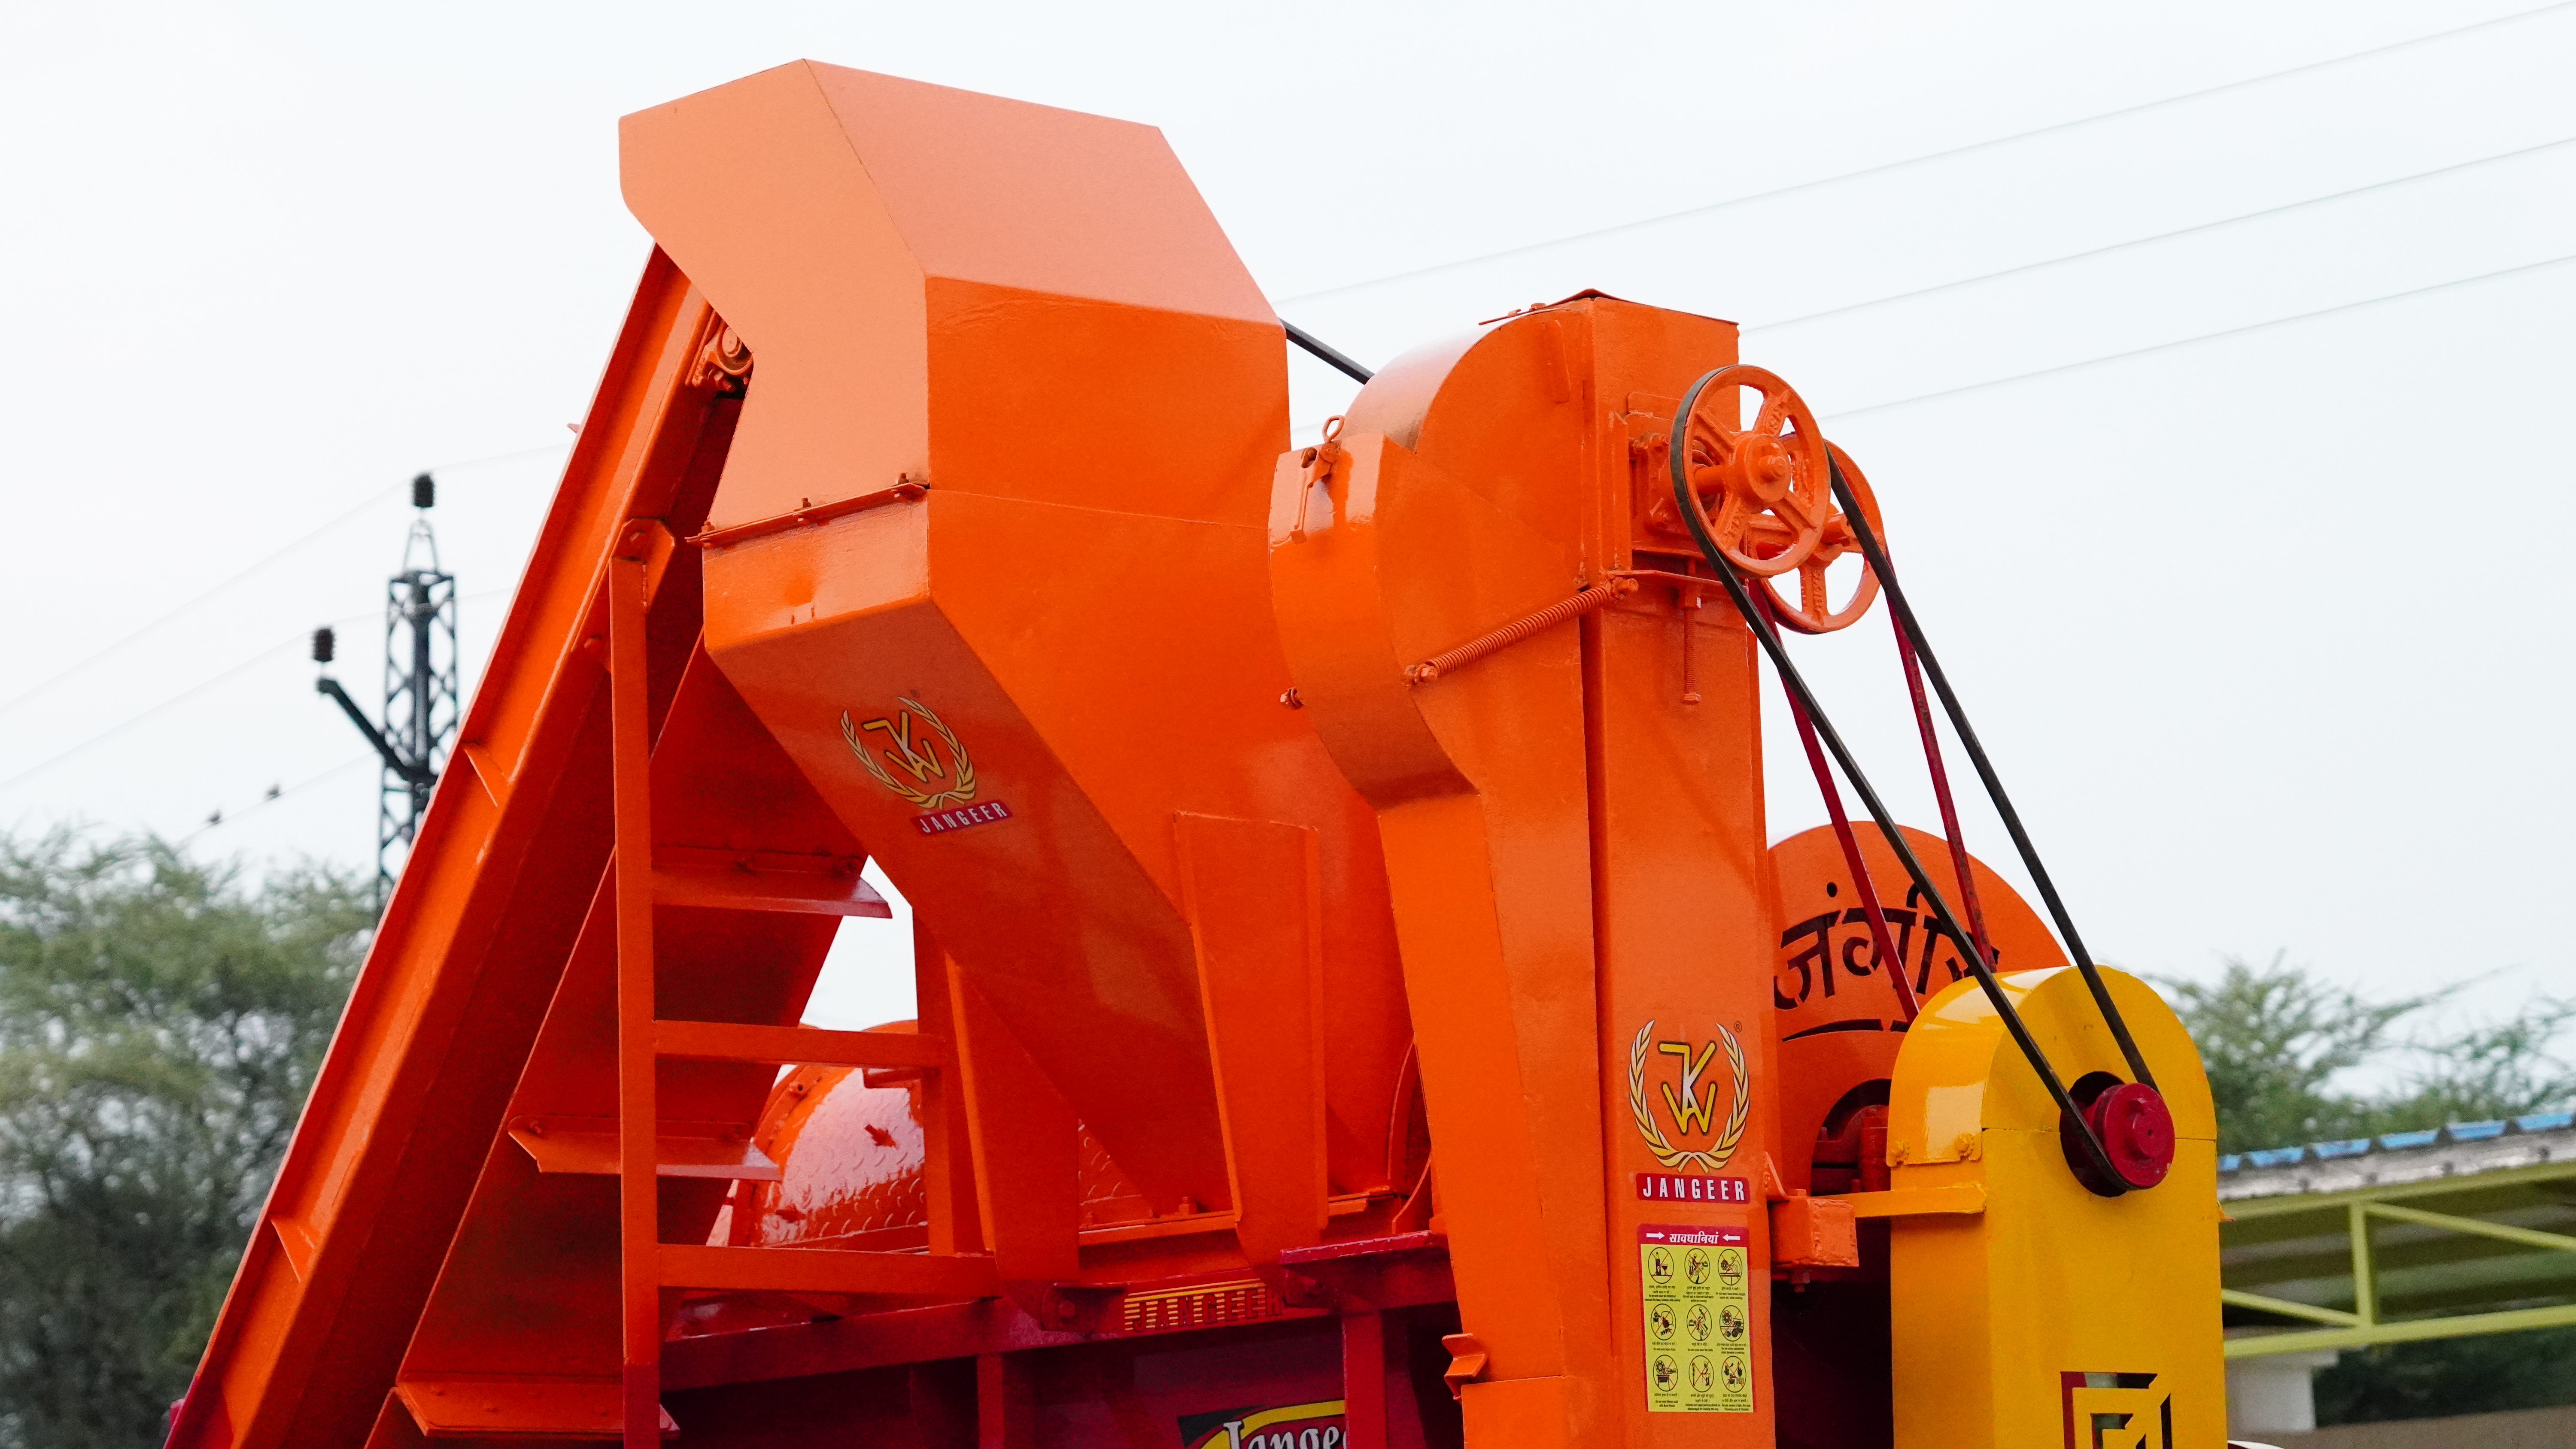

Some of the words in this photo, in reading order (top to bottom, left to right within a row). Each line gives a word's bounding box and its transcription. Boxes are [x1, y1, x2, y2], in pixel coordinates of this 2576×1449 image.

[919, 802, 1007, 833] JANGEER
[1643, 1177, 1745, 1201] JANGEER
[1669, 1231, 1719, 1244] सावधानियां
[1132, 1287, 1282, 1332] JANGEER
[1223, 1421, 1346, 1449] Jange
